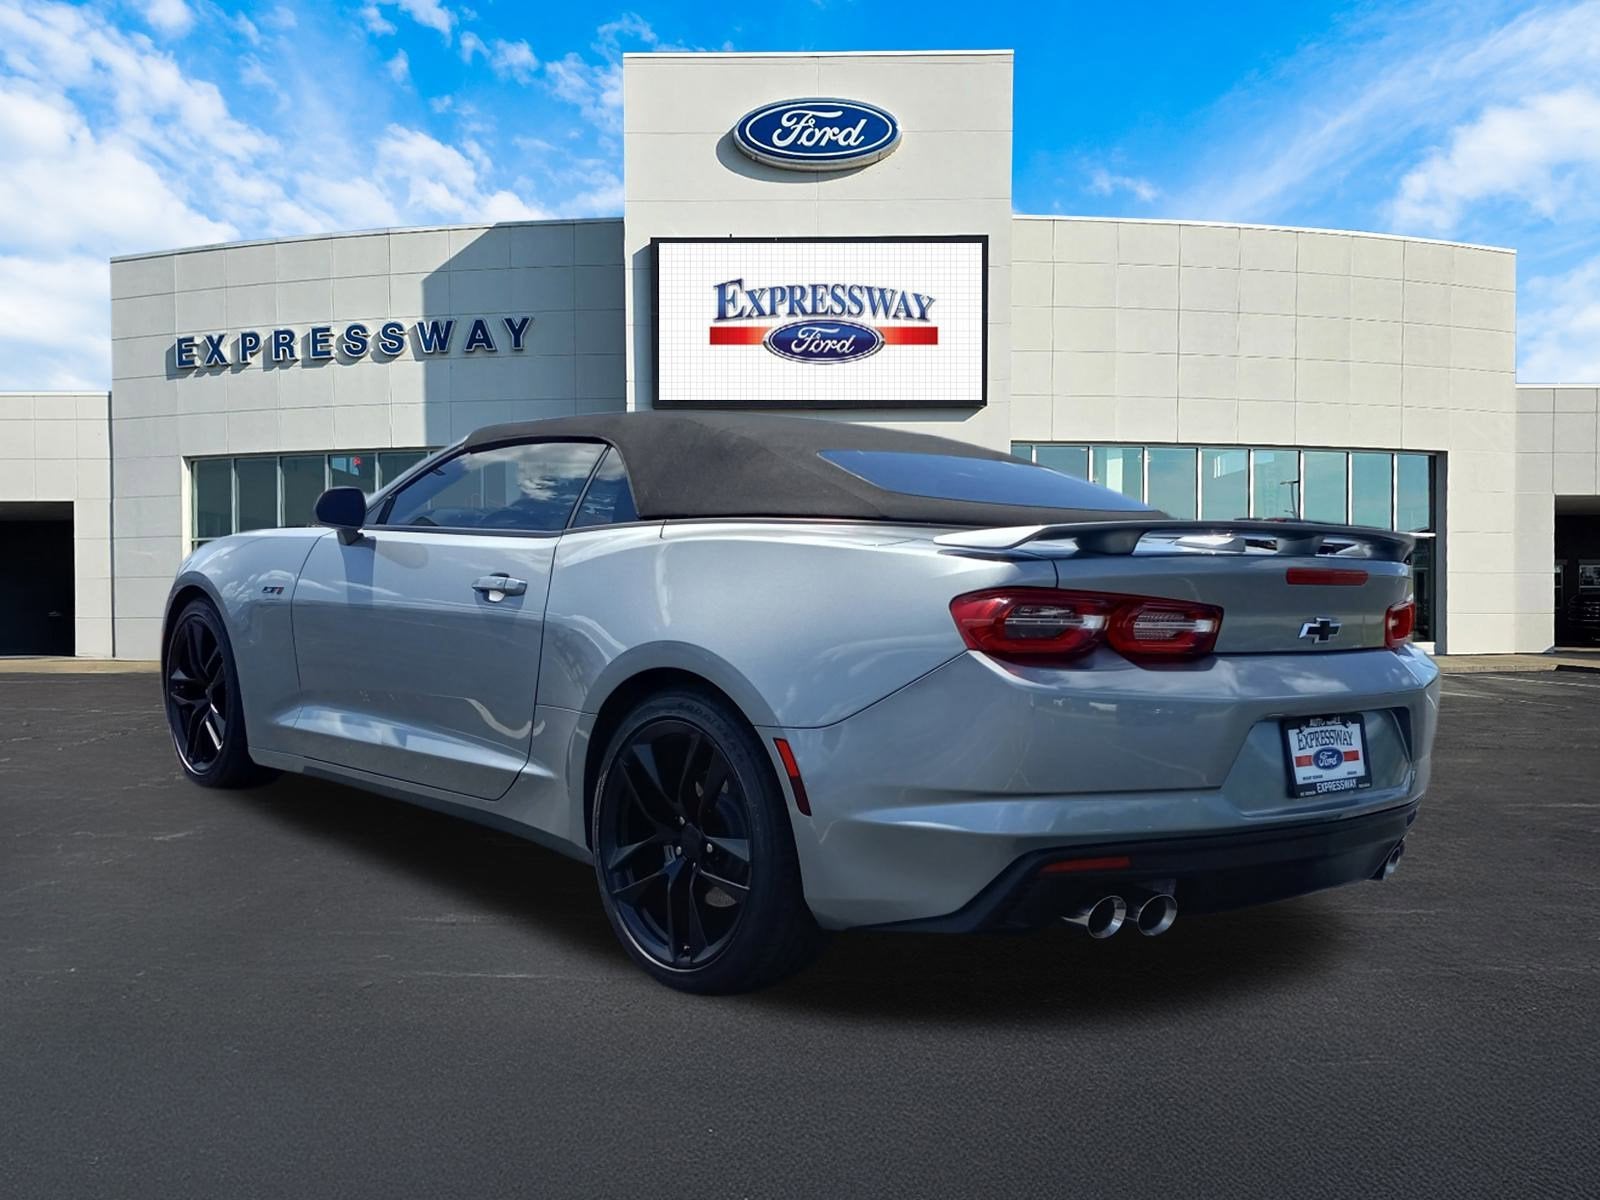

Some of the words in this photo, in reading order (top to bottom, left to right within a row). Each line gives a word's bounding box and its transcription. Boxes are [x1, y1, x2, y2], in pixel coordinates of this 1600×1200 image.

[772, 109, 868, 147] Ford
[713, 278, 936, 322] EXPRESSWAY
[175, 316, 533, 369] EXPRESSWAY
[791, 326, 855, 354] Ford
[1297, 730, 1354, 750] EXPRESSWAY
[1319, 752, 1338, 767] Ford
[1316, 779, 1357, 793] EXPRESSWAY
